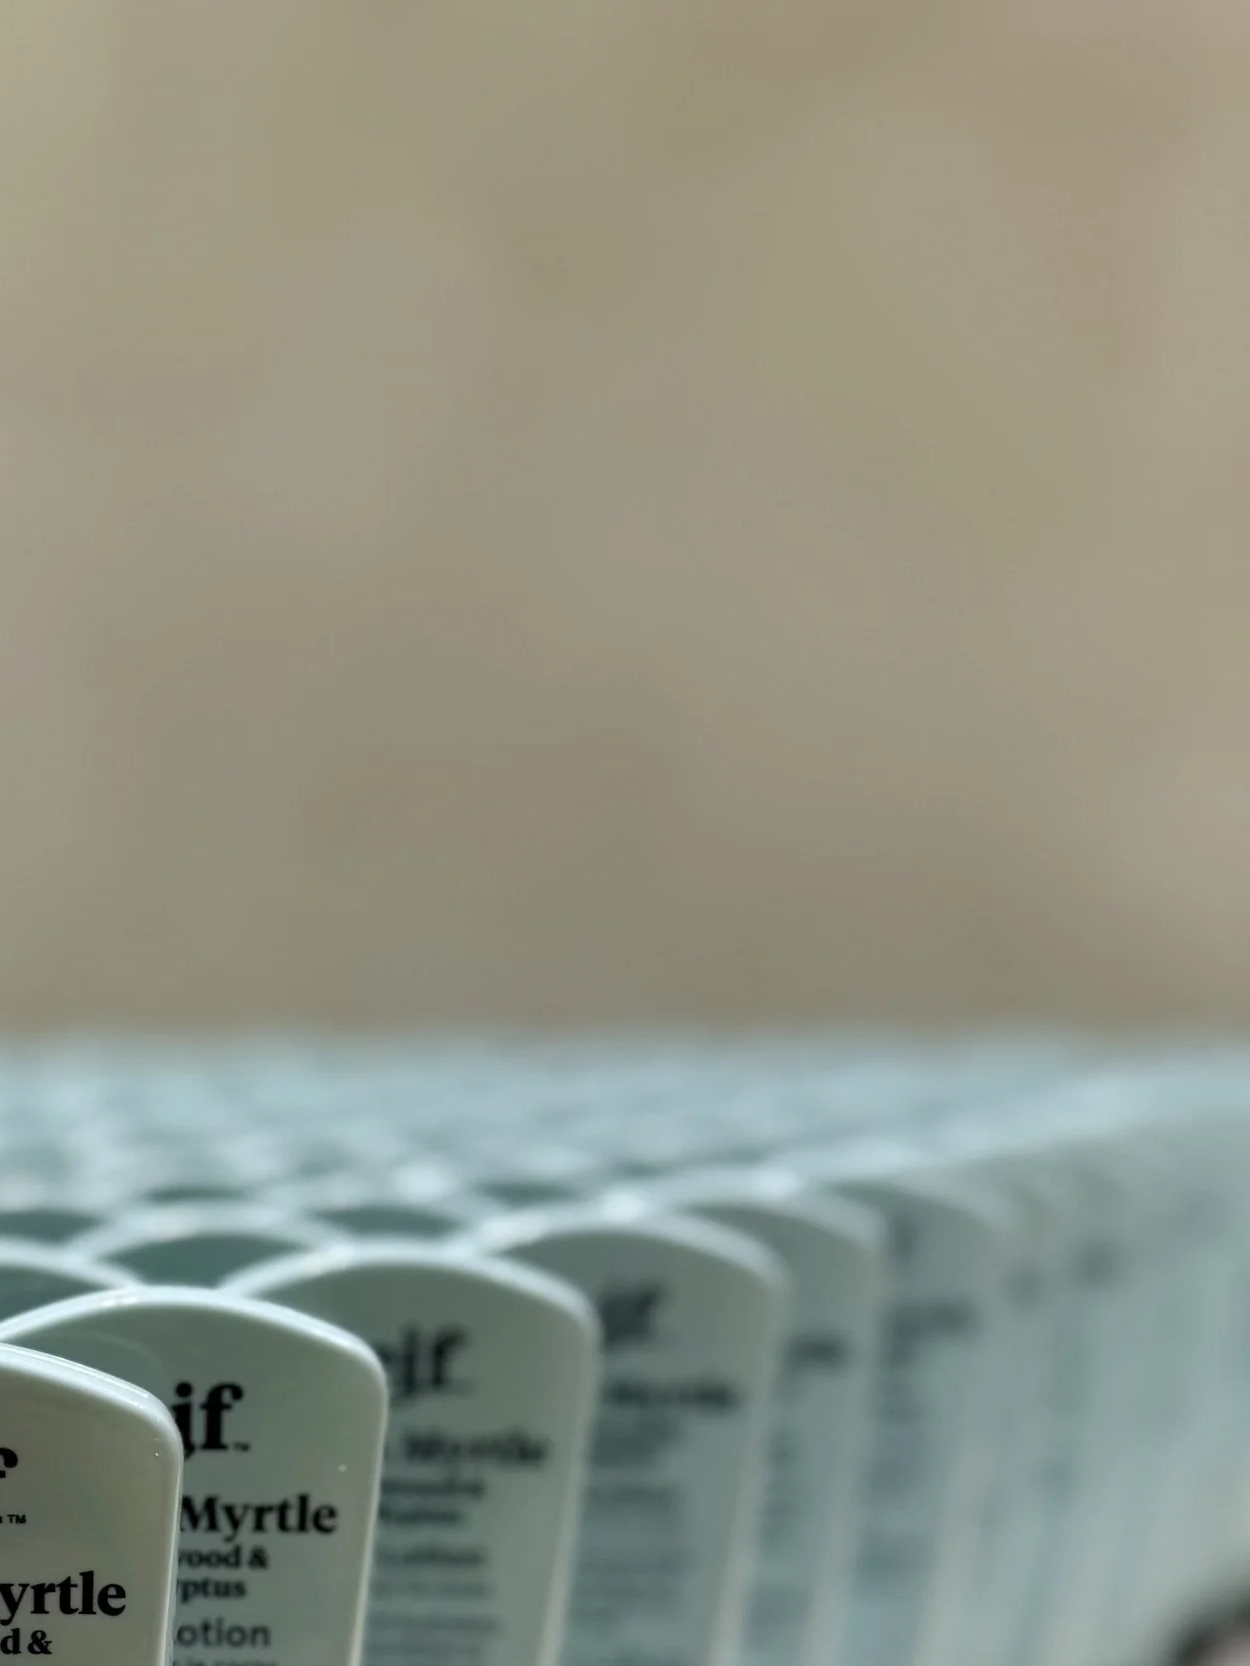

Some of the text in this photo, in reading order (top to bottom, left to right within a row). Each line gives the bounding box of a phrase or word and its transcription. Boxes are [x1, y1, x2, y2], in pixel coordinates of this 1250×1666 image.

[181, 1494, 339, 1542] Myrtle
[27, 1630, 53, 1655] &
[174, 1617, 271, 1647] otion
